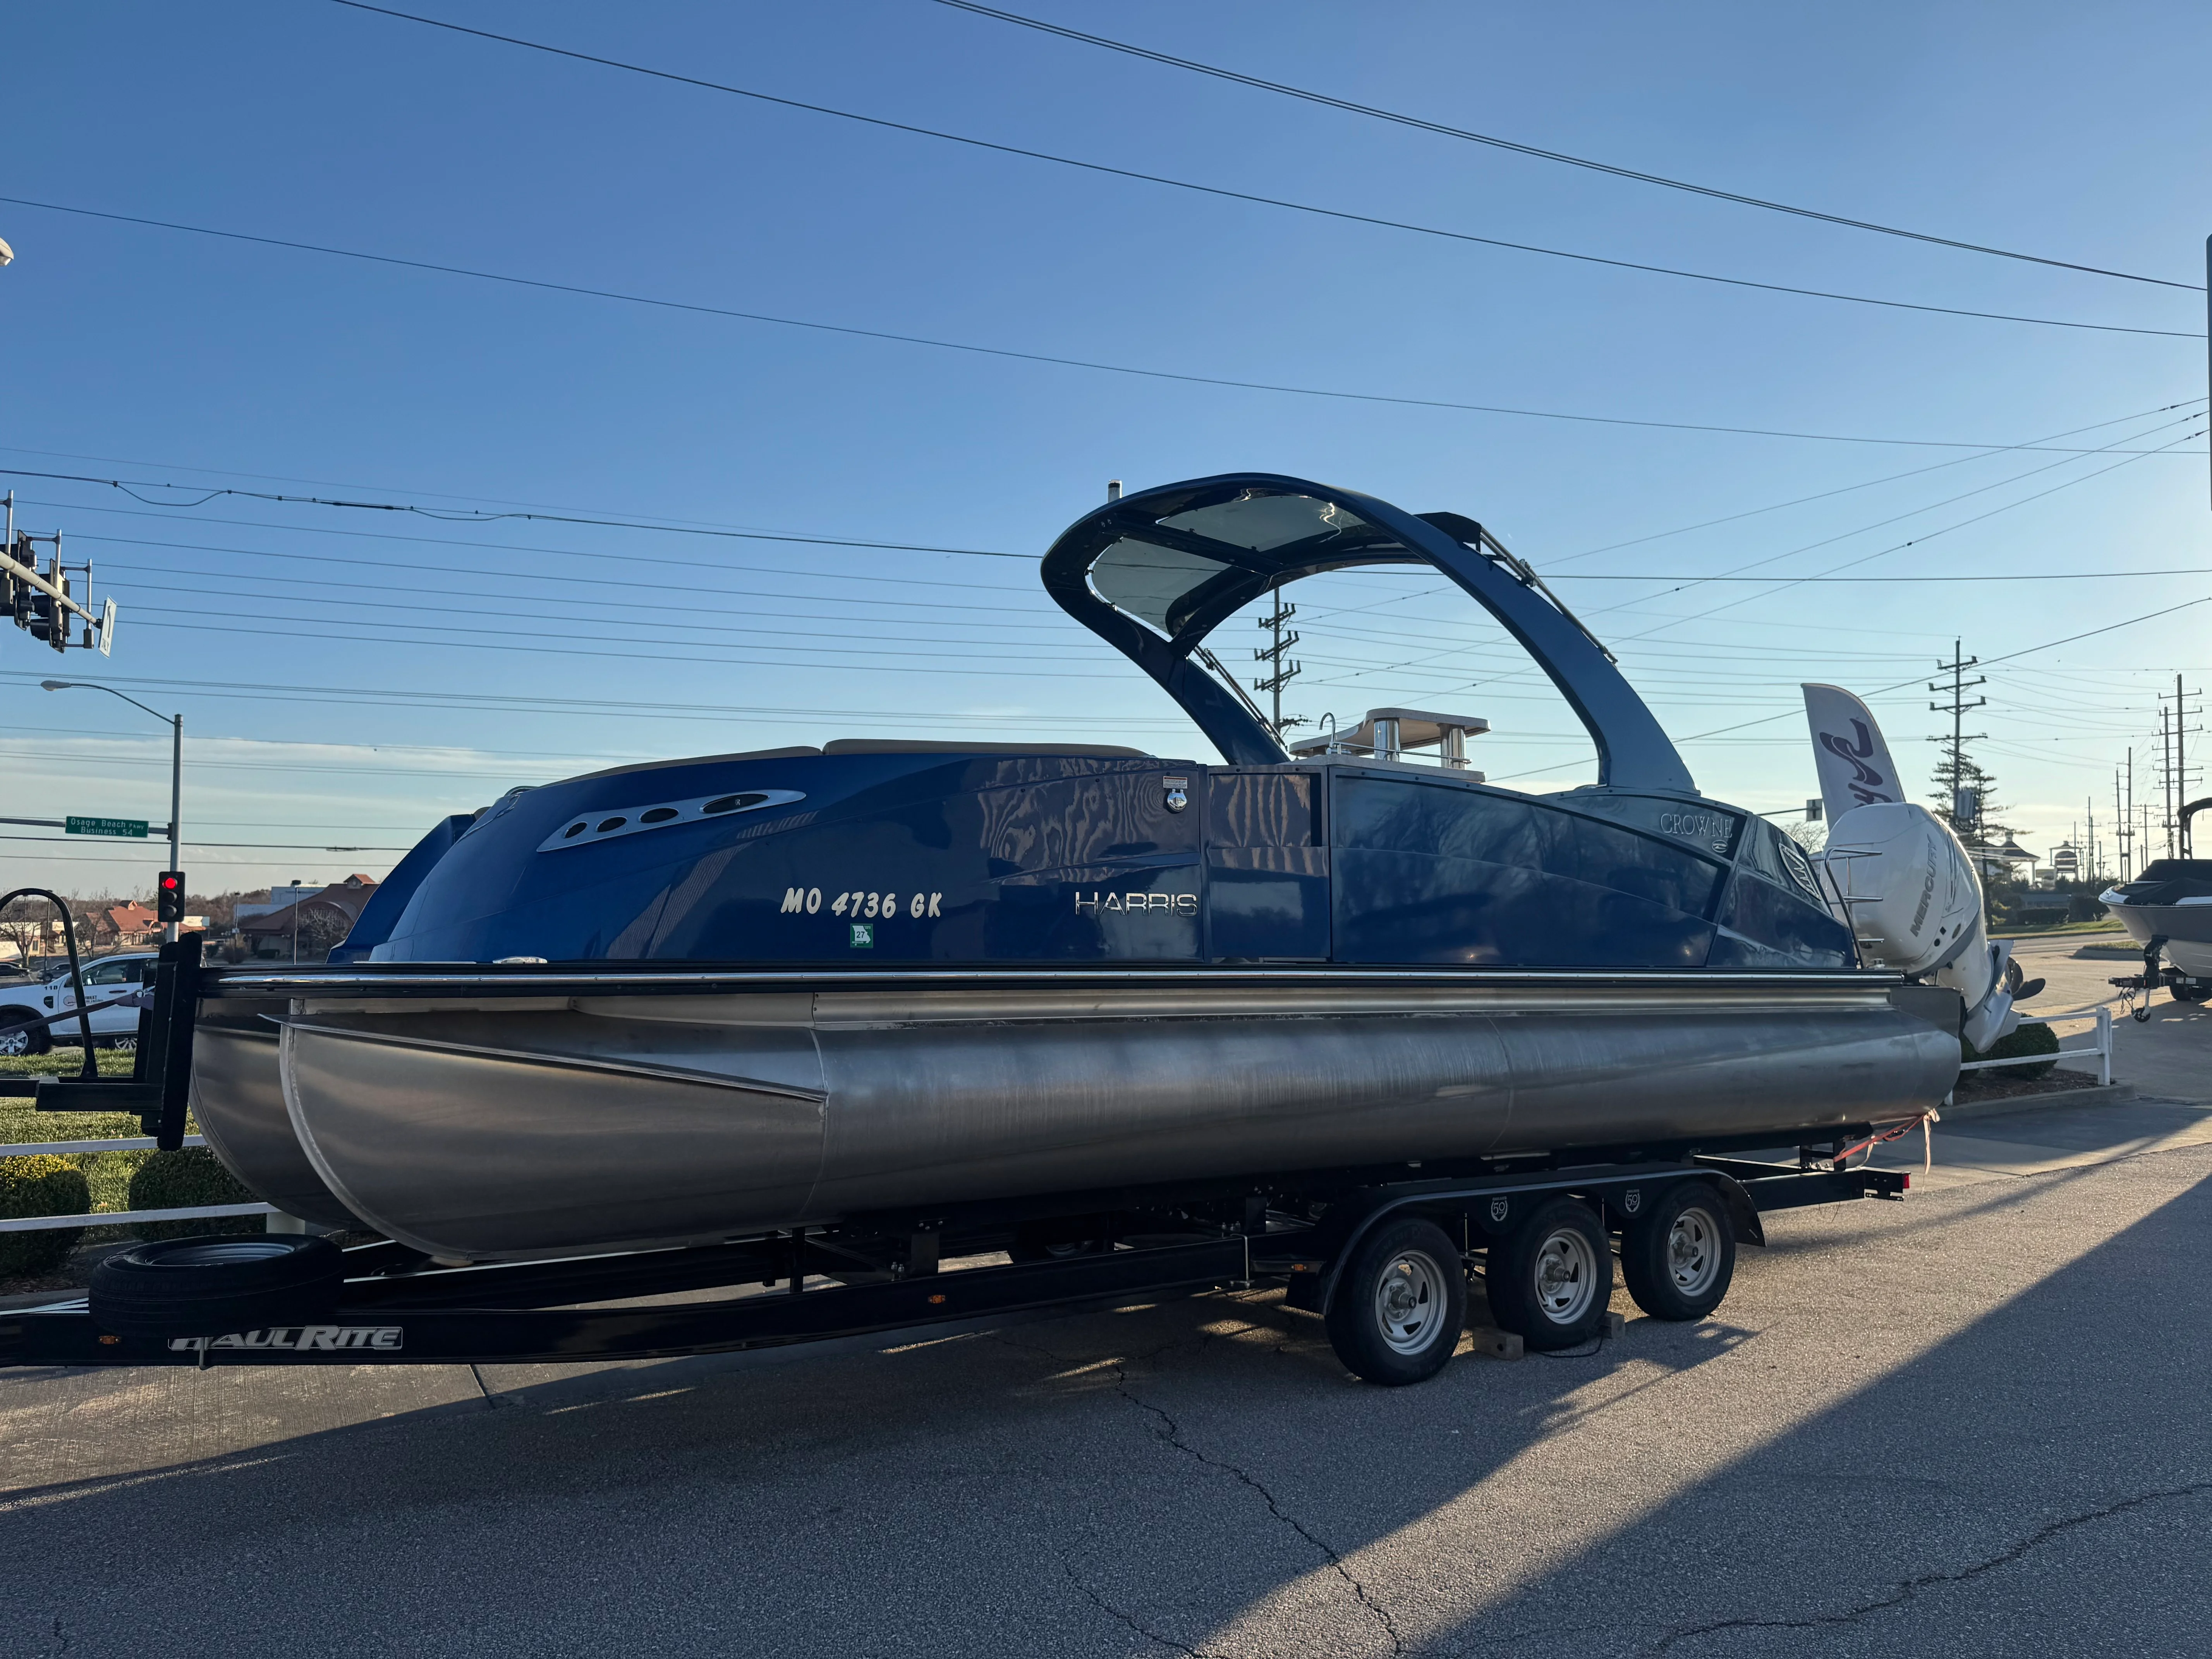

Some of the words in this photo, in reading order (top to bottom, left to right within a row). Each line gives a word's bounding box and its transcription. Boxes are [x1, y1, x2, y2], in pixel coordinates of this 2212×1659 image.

[71, 818, 96, 827] Osage
[81, 826, 116, 835] Business
[1661, 813, 1733, 838] CROWNE
[1910, 833, 1937, 937] MERCURY
[780, 887, 821, 914] MO
[831, 891, 896, 918] 4736
[910, 892, 942, 918] GK
[1075, 891, 1197, 917] HARRIS
[1493, 1202, 1505, 1215] 50
[1627, 1194, 1638, 1206] 50
